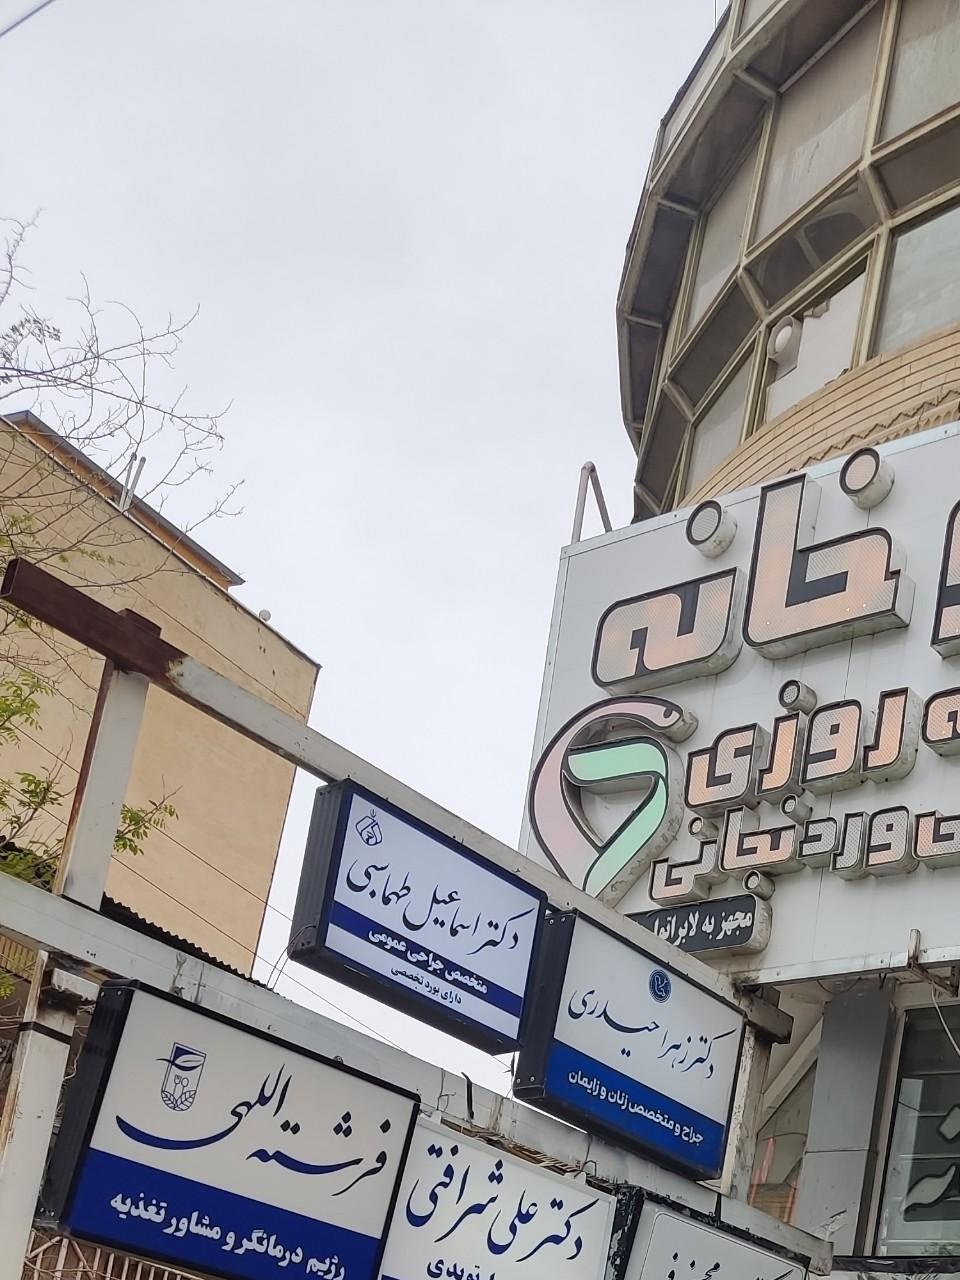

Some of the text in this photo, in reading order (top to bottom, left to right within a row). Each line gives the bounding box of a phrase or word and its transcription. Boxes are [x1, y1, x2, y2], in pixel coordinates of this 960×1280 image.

[687, 680, 911, 809] روزی
[345, 858, 536, 956] دکتر اسماعیل طهماسبی
[701, 914, 715, 940] به
[716, 911, 753, 941] مجهز
[367, 928, 488, 994] متخصص جراحی عمومی
[390, 966, 462, 1004] دارای بورد تخصصی
[567, 988, 737, 1080] دکتر زهرا حیدری
[115, 1063, 391, 1197] فرشته اللهی
[568, 1070, 704, 1147] جراح و متخصص زنان و زایمان
[109, 1192, 168, 1224] تغذیه
[162, 1210, 222, 1240] مشاور
[405, 1143, 600, 1263] دکتر علی شرافتی
[221, 1230, 235, 1251] و
[234, 1229, 303, 1268] درمانگر
